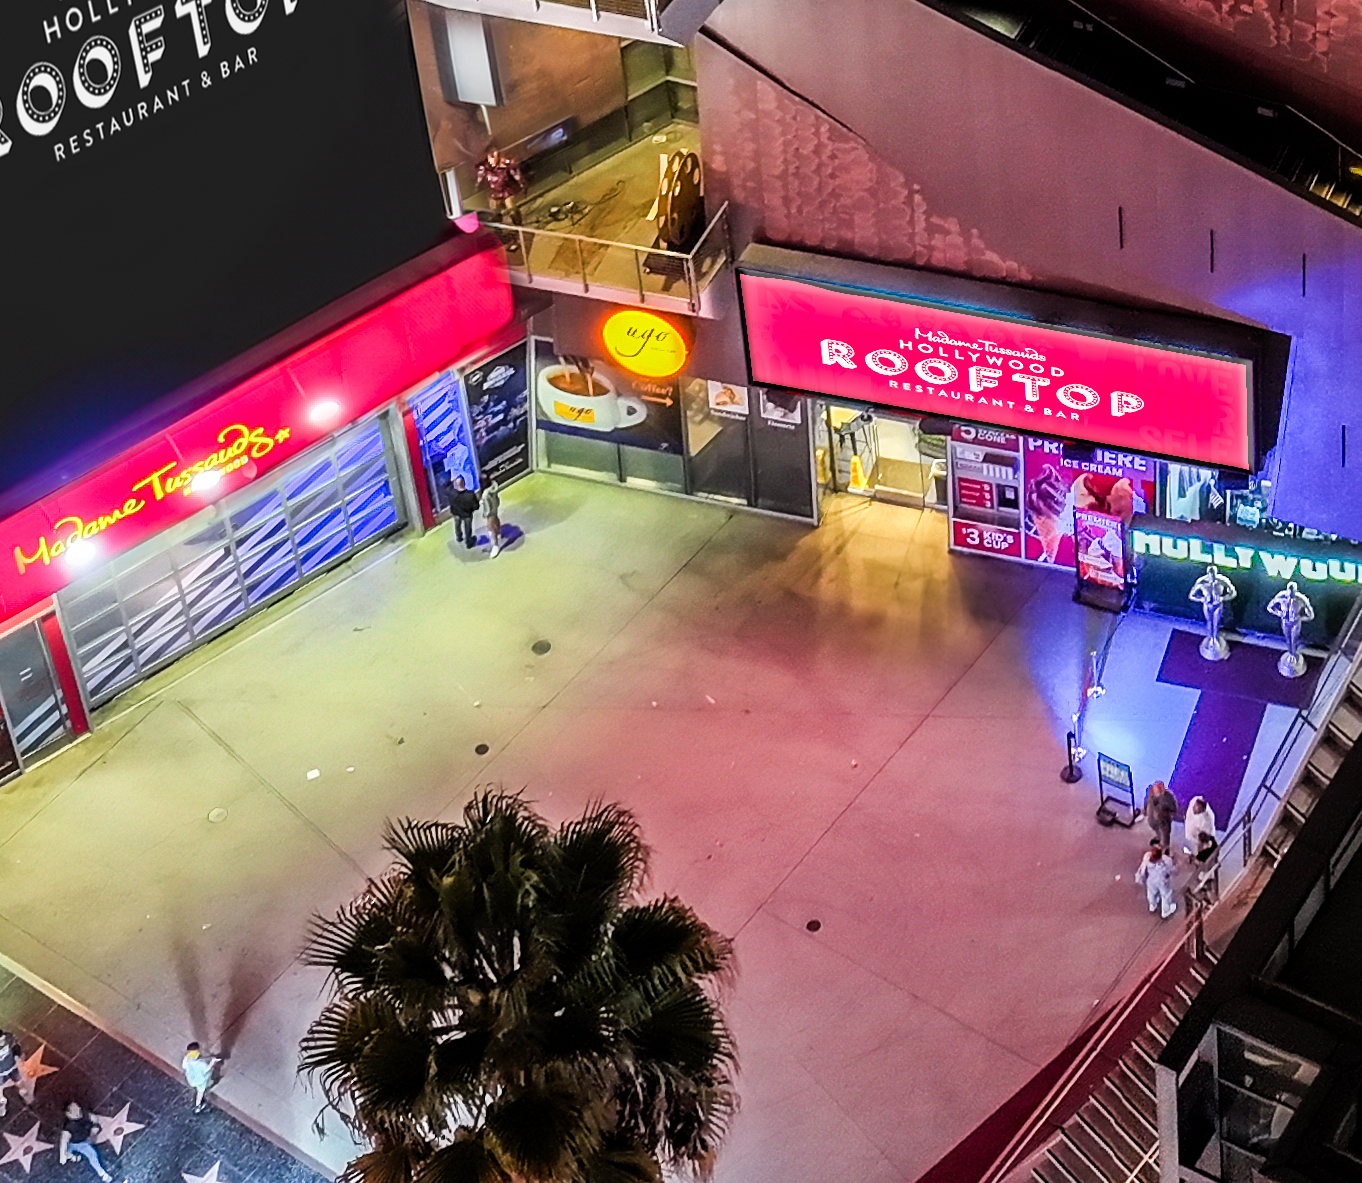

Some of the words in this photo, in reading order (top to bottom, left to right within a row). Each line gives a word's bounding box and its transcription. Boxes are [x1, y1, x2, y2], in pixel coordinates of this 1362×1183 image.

[53, 79, 191, 162] RESTAURANT
[200, 70, 212, 88] &
[220, 47, 259, 78] BAR
[614, 326, 670, 357] ugo
[899, 339, 1065, 377] HOLLYWOOD
[914, 327, 983, 352] Madame
[977, 339, 1047, 363] Tussauds
[820, 338, 1144, 418] ROOFTOP
[888, 380, 1015, 410] RESTAURANT
[1024, 404, 1035, 413] &
[1043, 407, 1080, 421] BAR
[1081, 461, 1124, 478] CREAM
[13, 500, 145, 576] Madame
[132, 423, 275, 501] Tussauds
[982, 538, 1010, 550] CUP
